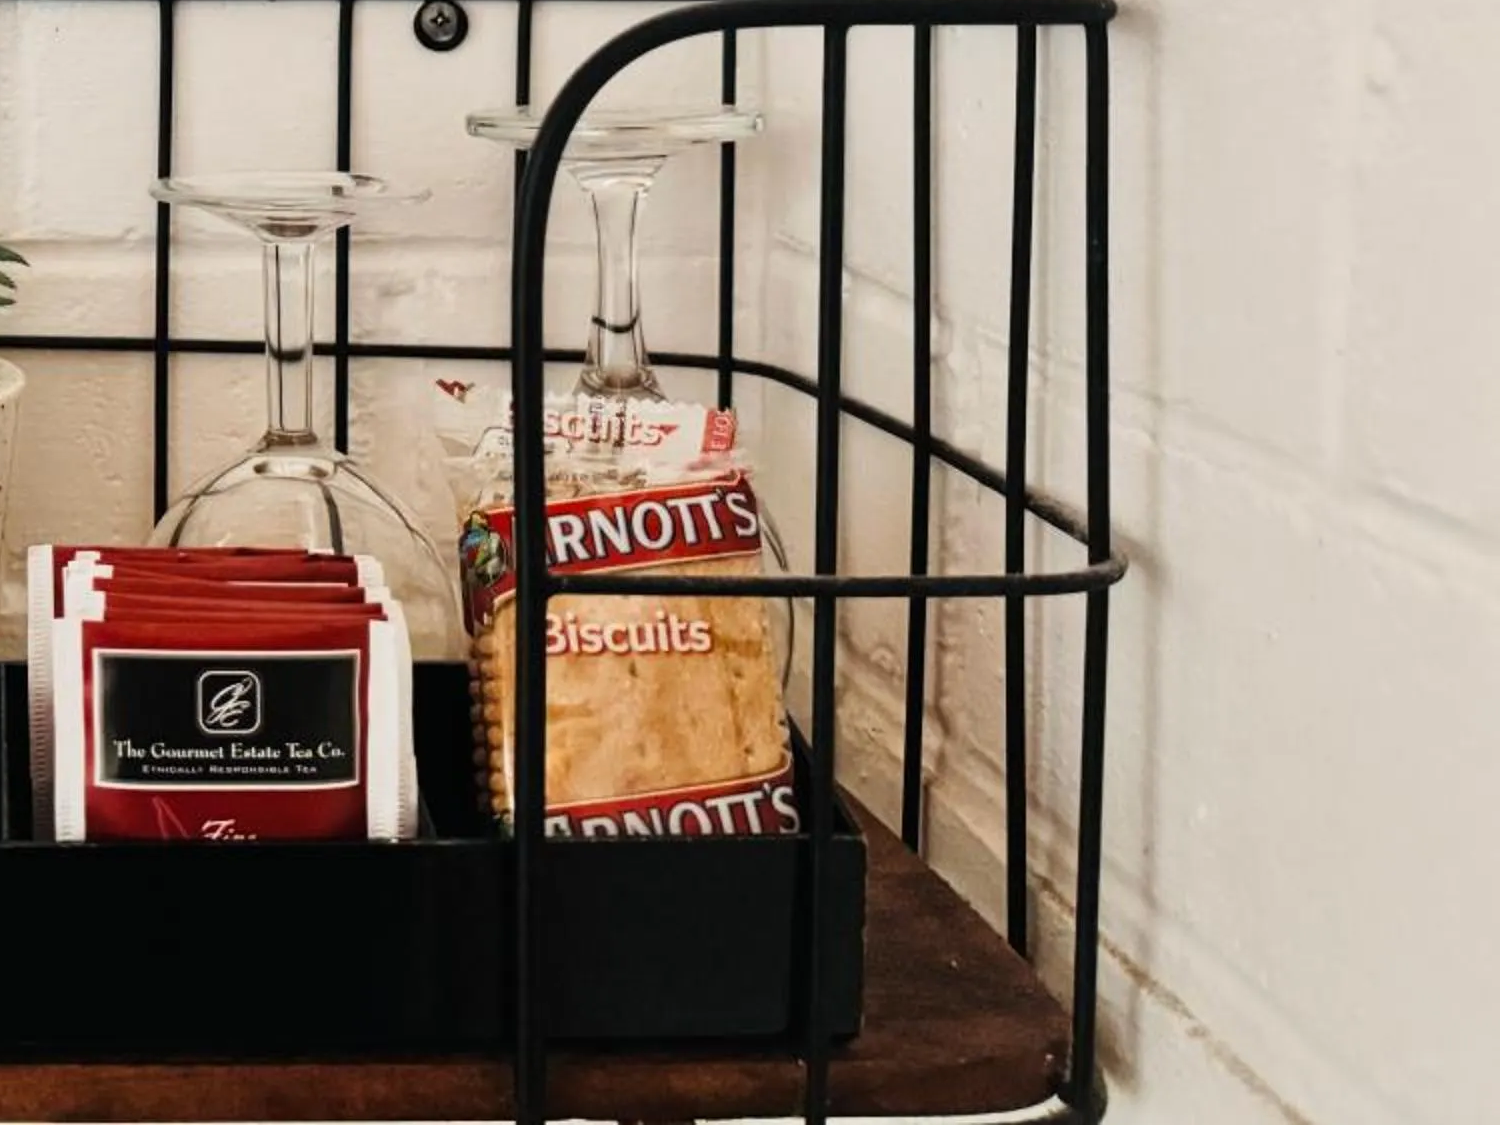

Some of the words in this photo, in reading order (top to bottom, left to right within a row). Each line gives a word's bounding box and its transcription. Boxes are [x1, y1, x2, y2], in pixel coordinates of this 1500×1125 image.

[545, 490, 759, 564] RNOTT'S
[546, 608, 712, 654] Biscuits
[113, 739, 145, 759] The
[150, 742, 224, 759] Gourmet
[231, 742, 281, 759] Estate
[286, 742, 313, 759] Tea
[317, 741, 346, 758] Co.
